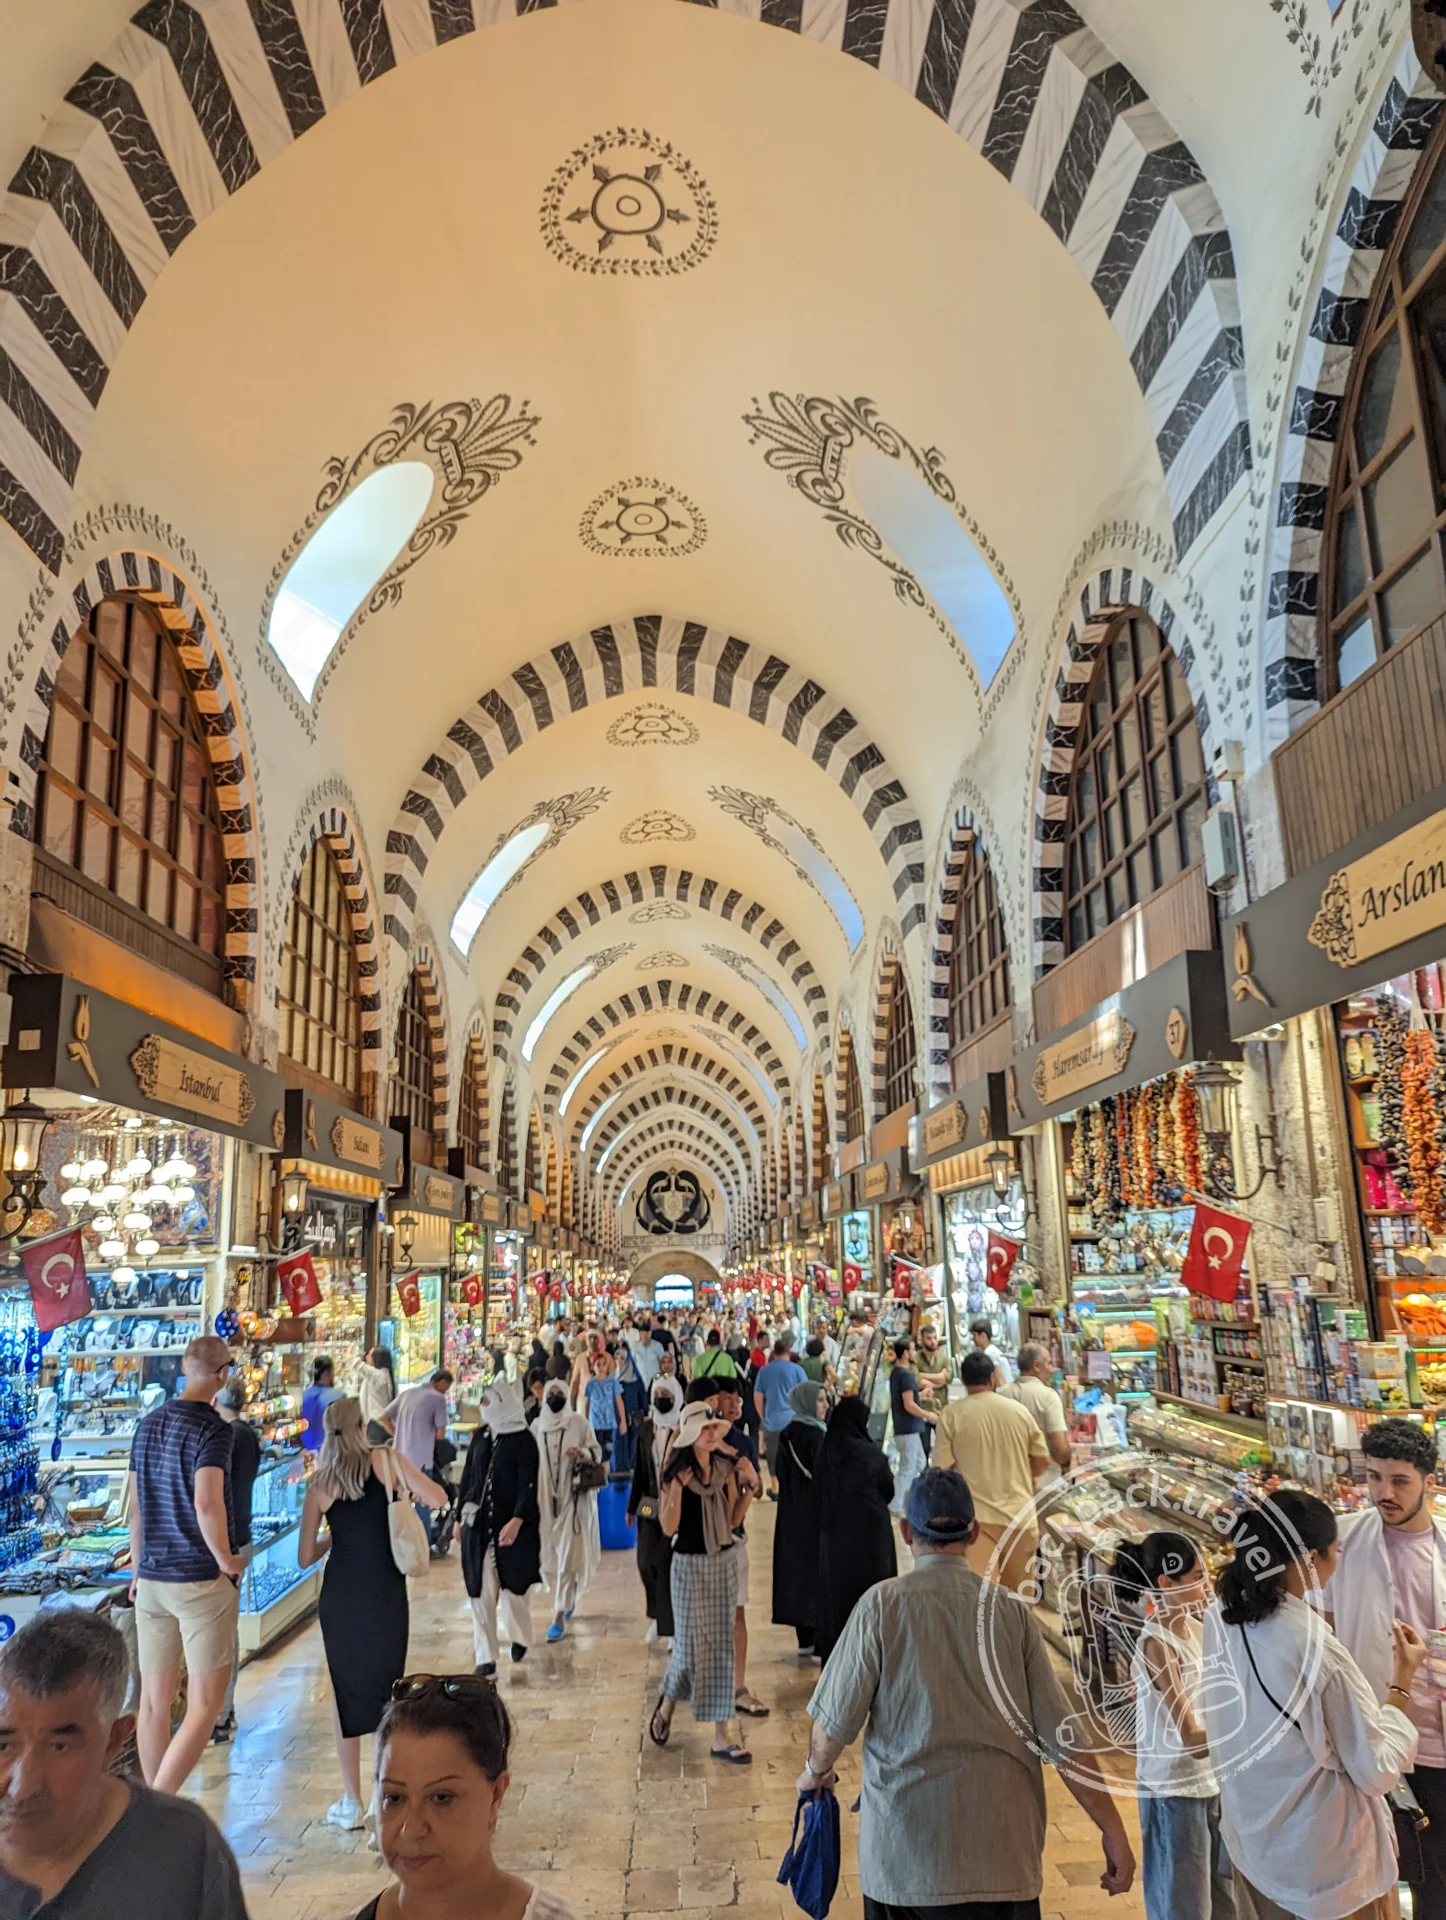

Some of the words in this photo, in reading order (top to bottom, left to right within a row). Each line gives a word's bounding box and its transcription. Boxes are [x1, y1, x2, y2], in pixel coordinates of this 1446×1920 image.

[1358, 860, 1446, 928] Arslan
[1168, 1019, 1180, 1045] 37
[1052, 1042, 1105, 1080] Haremsaray
[179, 1064, 223, 1103] İstanbul
